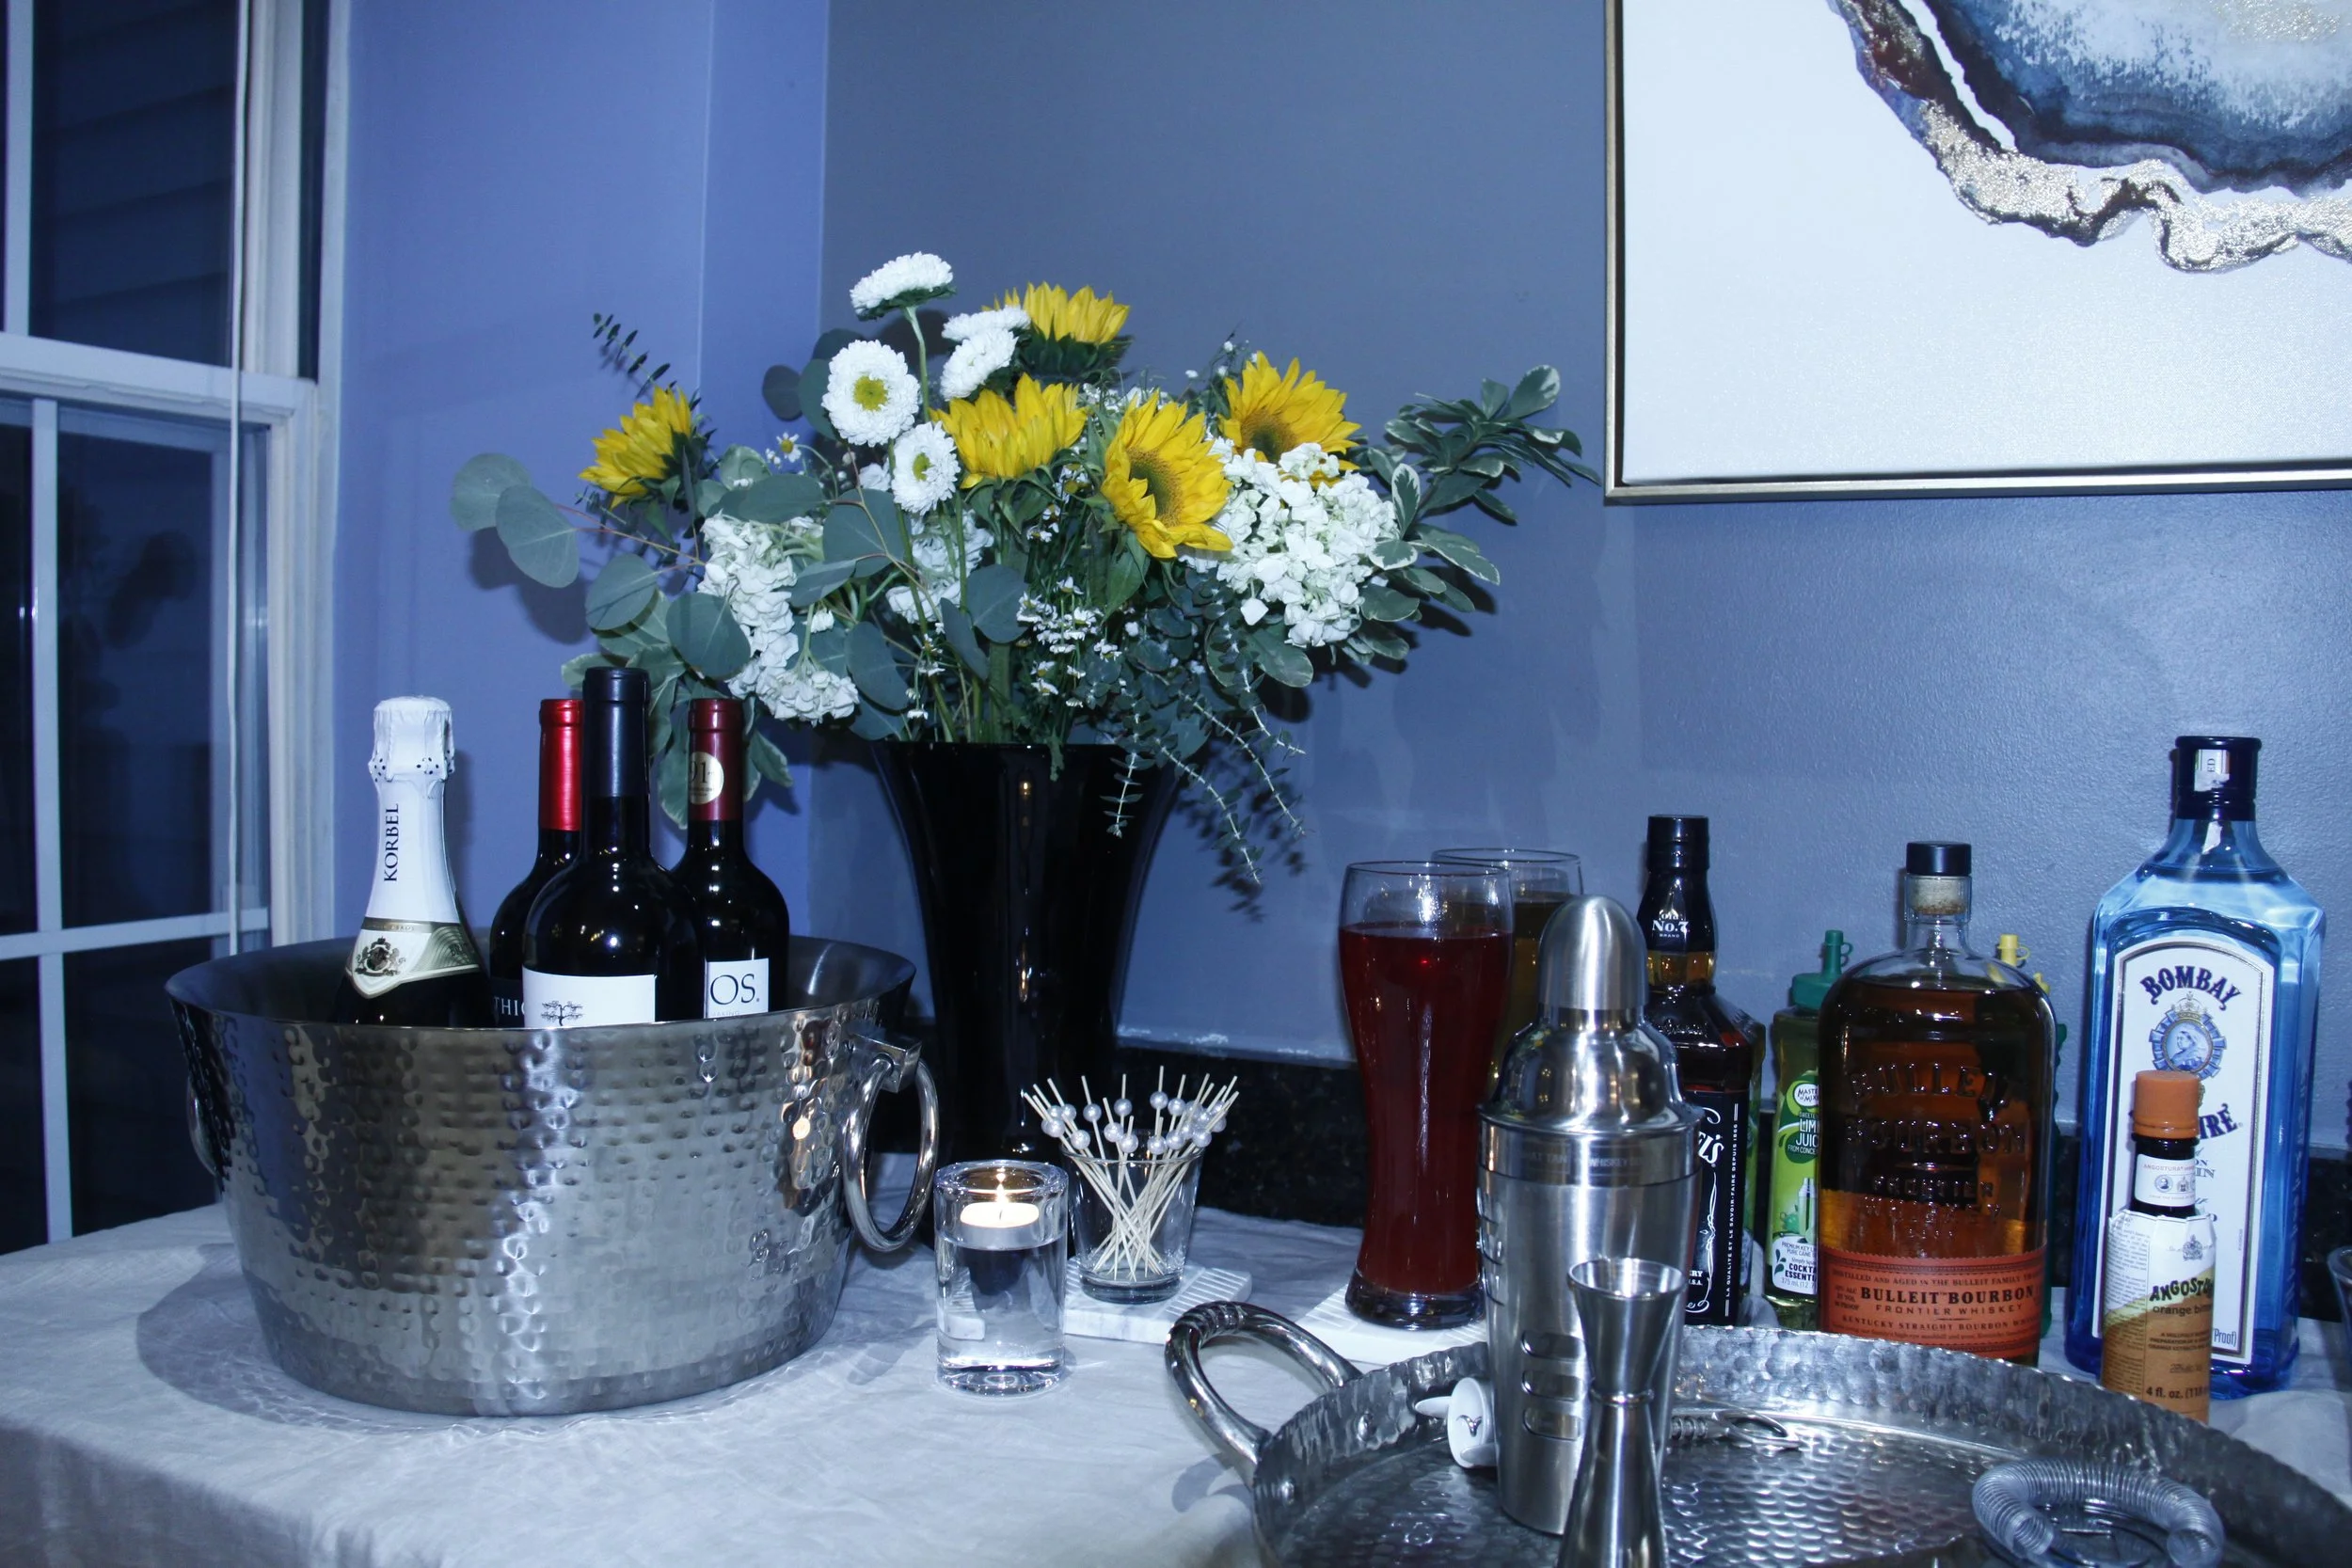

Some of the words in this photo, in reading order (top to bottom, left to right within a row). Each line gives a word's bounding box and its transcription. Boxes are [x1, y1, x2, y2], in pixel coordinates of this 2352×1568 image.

[384, 803, 399, 881] KORBEL
[2139, 965, 2242, 1011] BOMBAY
[1992, 1276, 2021, 1285] FAMILY
[1948, 1285, 2034, 1305] BOURBON
[1876, 1304, 1950, 1316] FRONTIER
[1959, 1303, 2023, 1315] WHISKEY
[2153, 1305, 2192, 1317] orange
[1842, 1315, 1894, 1328] KENTUCKY
[1899, 1322, 1953, 1331] STRAIGHT
[1959, 1322, 2009, 1331] BOURBON
[2146, 1386, 2153, 1396] 4
[2155, 1386, 2166, 1398] fl.
[2169, 1390, 2184, 1400] oz.
